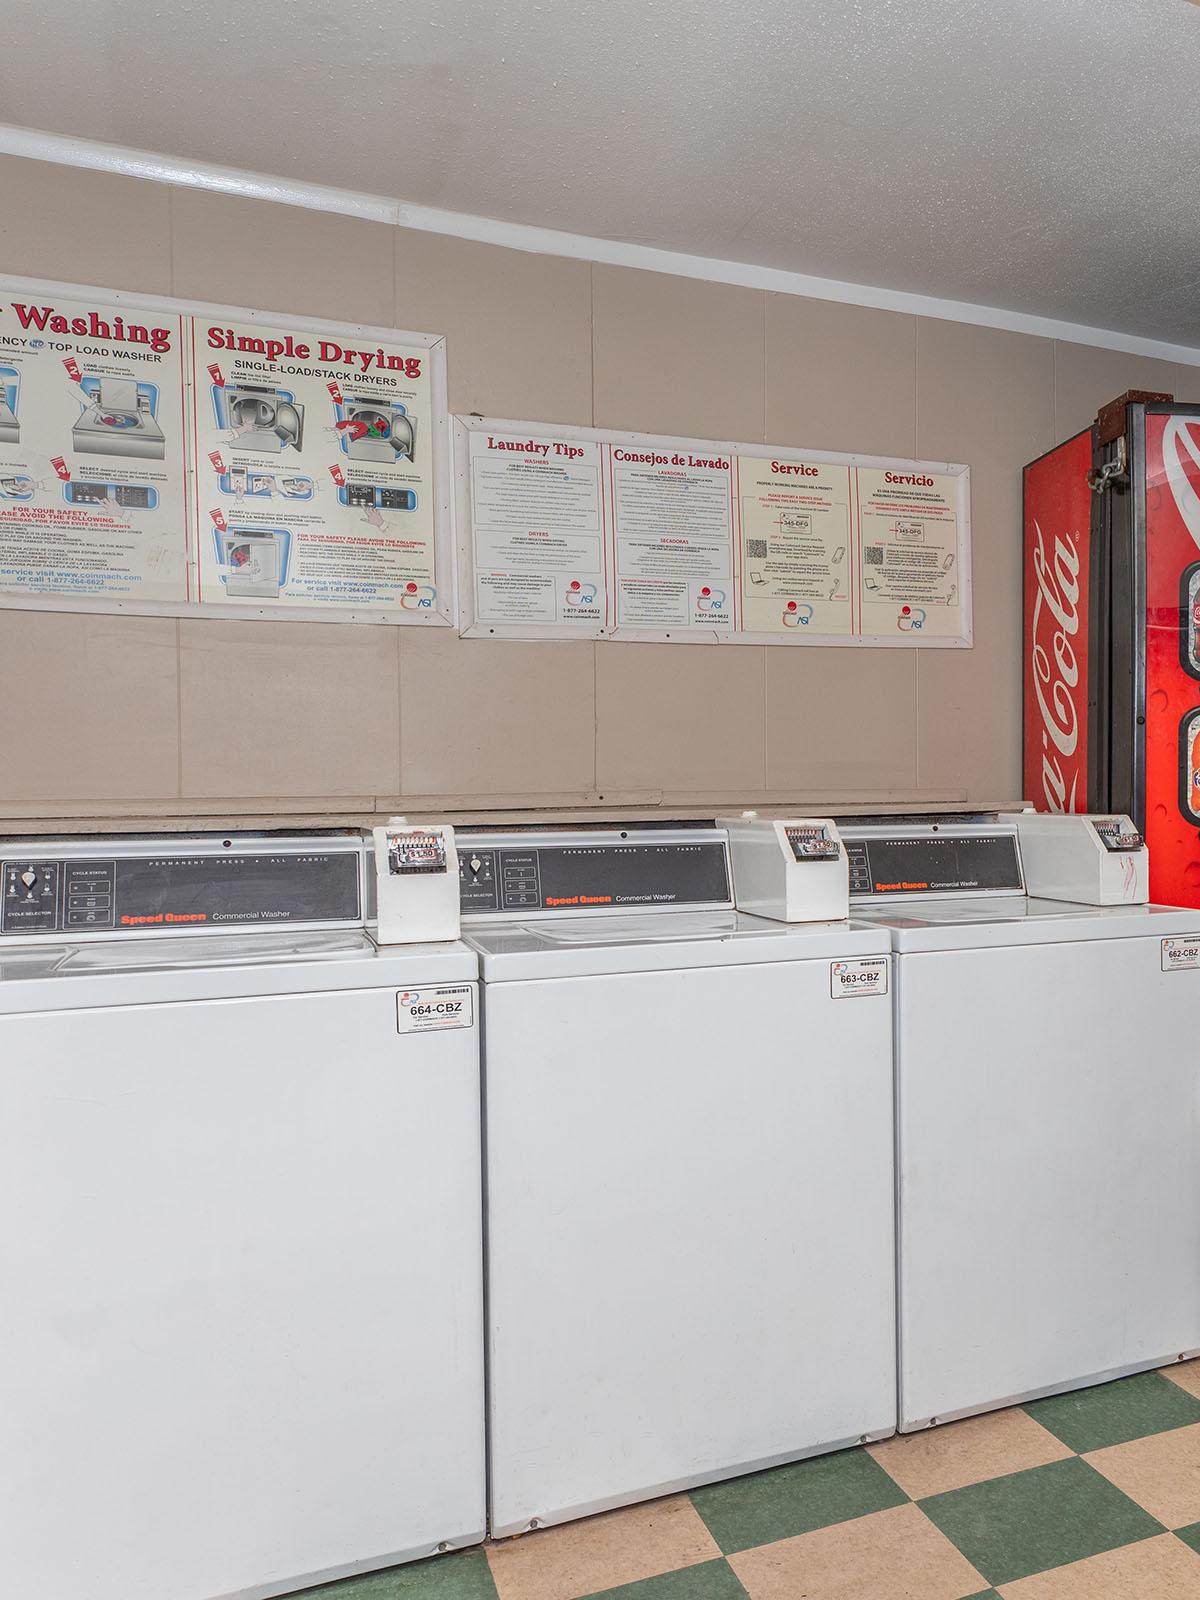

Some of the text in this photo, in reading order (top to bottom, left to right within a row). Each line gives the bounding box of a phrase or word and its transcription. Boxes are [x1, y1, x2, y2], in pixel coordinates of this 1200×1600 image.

[11, 303, 171, 353] Washing
[48, 342, 72, 352] TOP
[76, 346, 108, 356] LOAD
[112, 350, 162, 363] WASHER
[207, 327, 422, 378] Simple Drying
[69, 365, 79, 376] 2
[234, 359, 397, 386] SINGLE-LOAD/STACK DRYERS
[488, 437, 584, 459] Laundry Tips
[614, 449, 730, 470] Consejos de Lavado
[771, 461, 818, 476] Service
[885, 472, 934, 487] Servicio
[67, 515, 114, 523] FOLLOWING
[46, 577, 104, 585] 1-877-264-6622
[57, 572, 142, 581] www.coinmach.com
[343, 581, 403, 589] www.coinmach.com
[410, 850, 433, 858] $1.50
[876, 882, 901, 891] Speed
[546, 896, 578, 906] Speed
[580, 895, 612, 903] Queen
[121, 910, 290, 925] Speed Queen Commercial Washer
[1169, 949, 1198, 958] 662-CBZ
[841, 973, 879, 983] 663-CBZ
[410, 1002, 462, 1015] 664-CBZ
